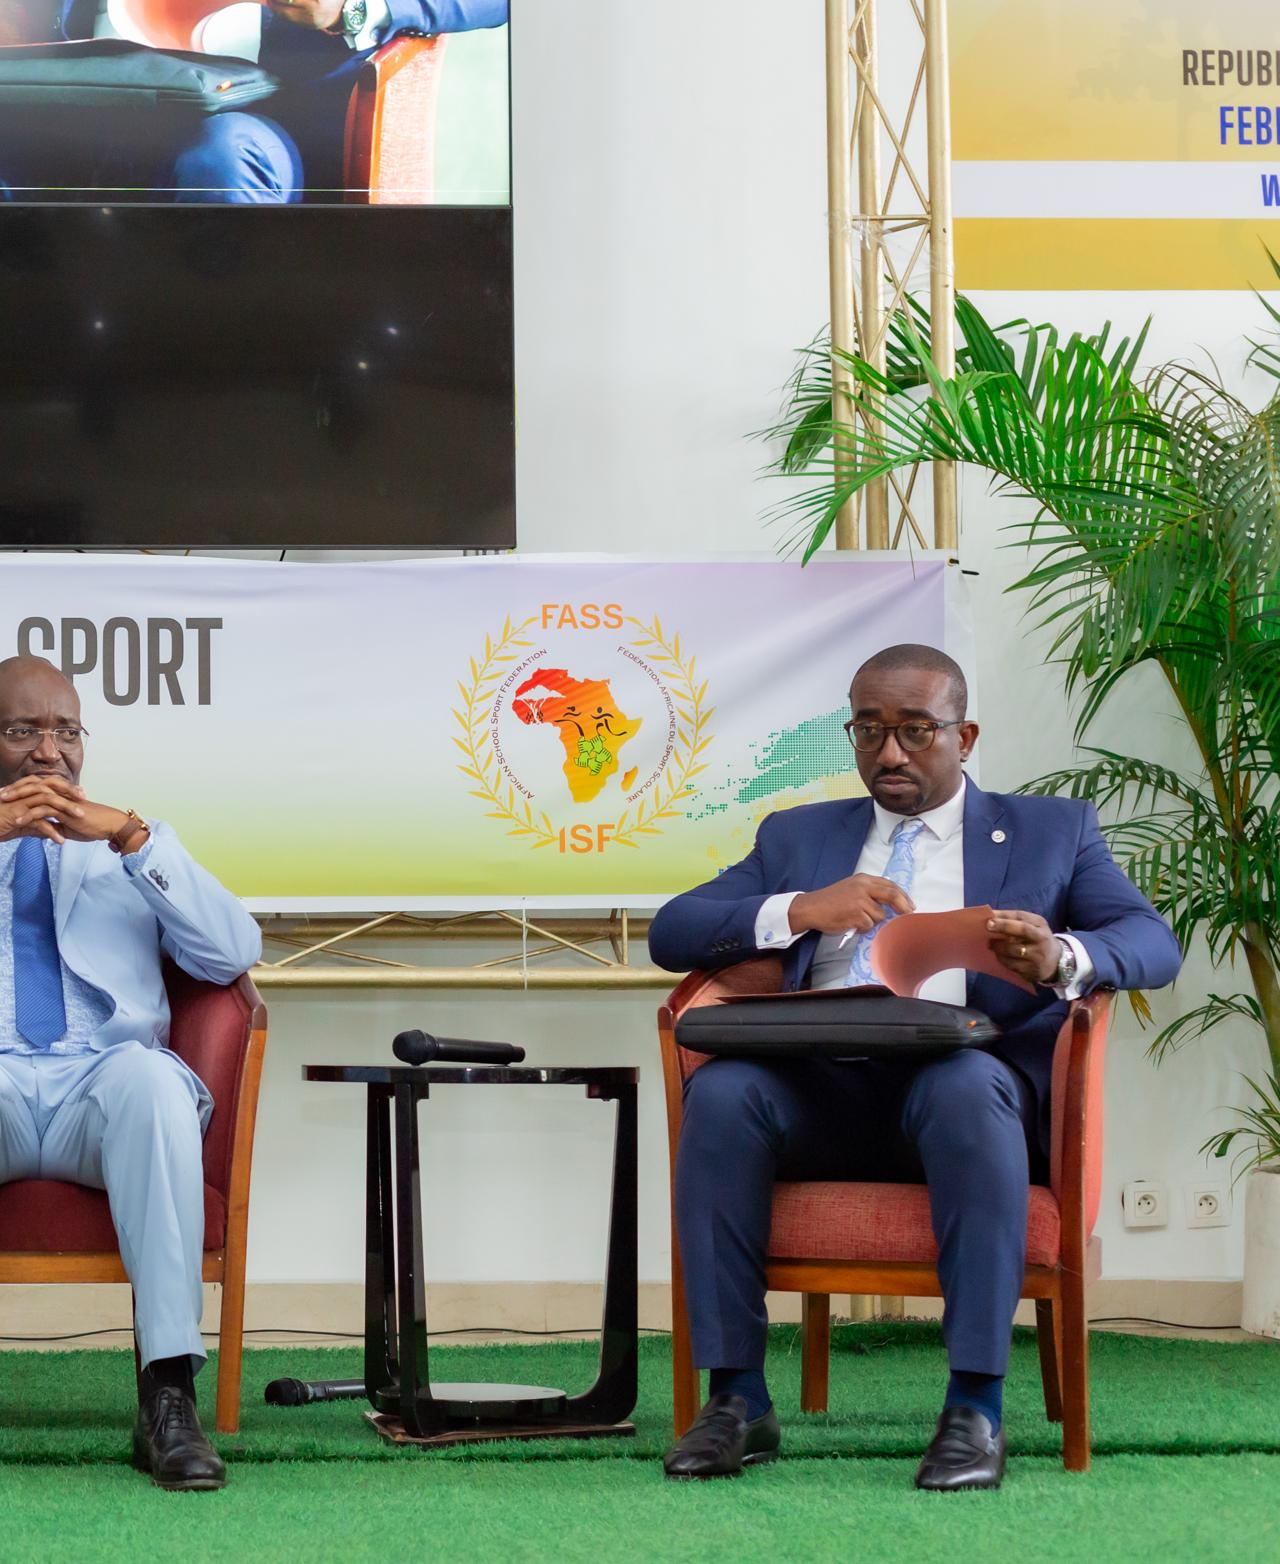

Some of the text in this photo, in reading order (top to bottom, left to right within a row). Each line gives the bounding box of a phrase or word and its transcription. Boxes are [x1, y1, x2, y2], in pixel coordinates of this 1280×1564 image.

[1182, 50, 1280, 86] REPUB
[1219, 106, 1280, 145] FEB
[541, 603, 624, 629] FASS
[491, 648, 548, 799] AFRICAN SCHOOL SPORT FEDERATION
[659, 686, 677, 729] AFRICAINE
[668, 730, 676, 742] DU
[659, 744, 674, 771] SPORT
[626, 771, 661, 803] SCOLAIRE
[559, 823, 615, 853] ISF
